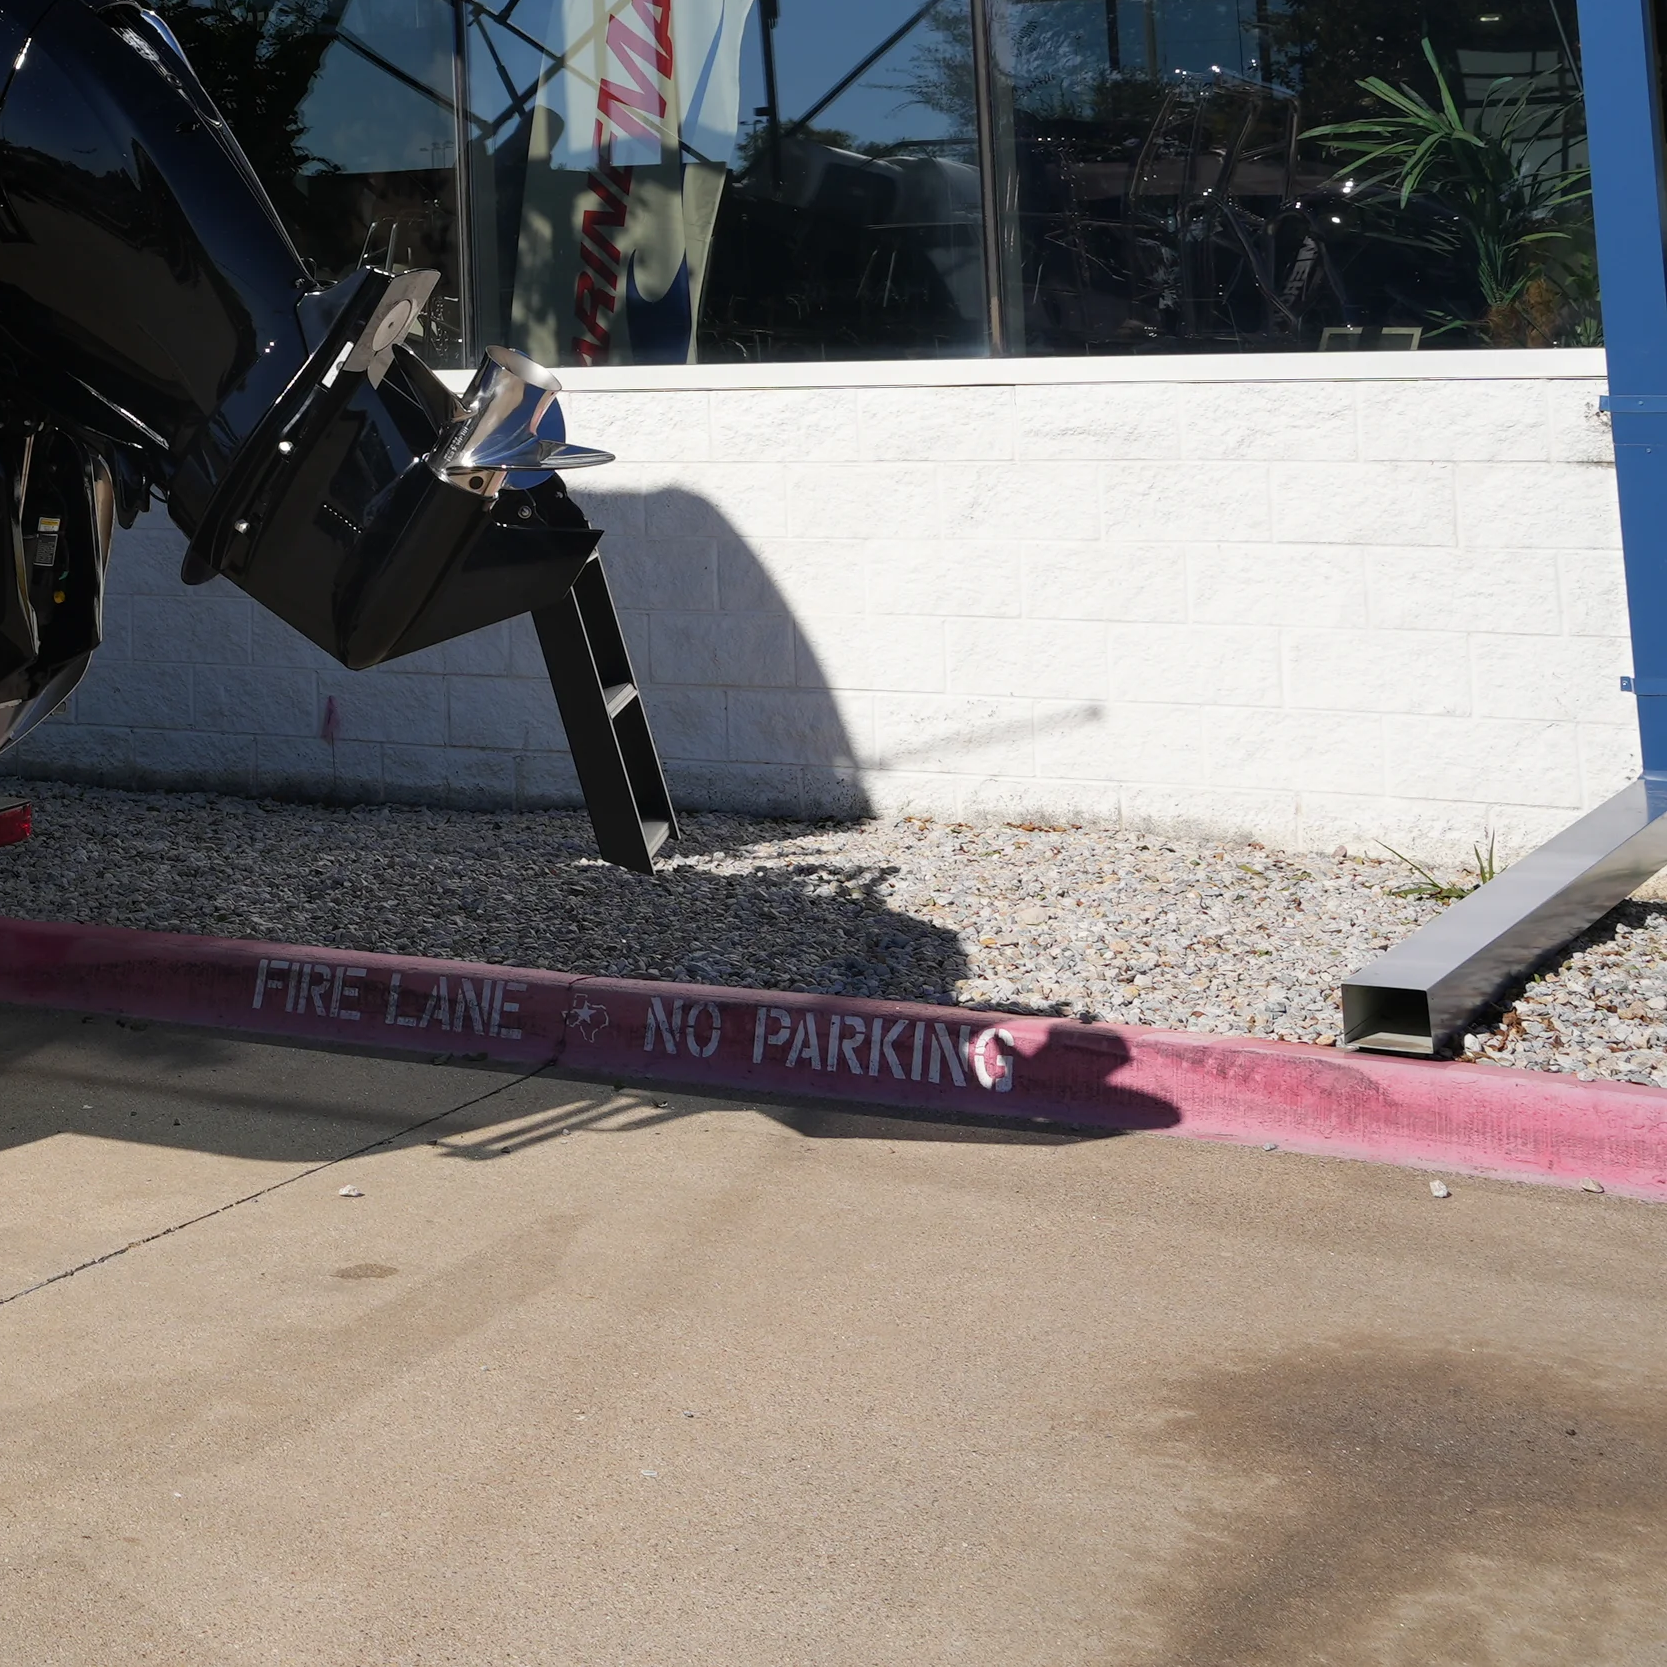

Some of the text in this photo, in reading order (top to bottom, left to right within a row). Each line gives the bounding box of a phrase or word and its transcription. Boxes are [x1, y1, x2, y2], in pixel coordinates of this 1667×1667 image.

[251, 958, 1015, 1093] FIRE LANE NO PARKING
